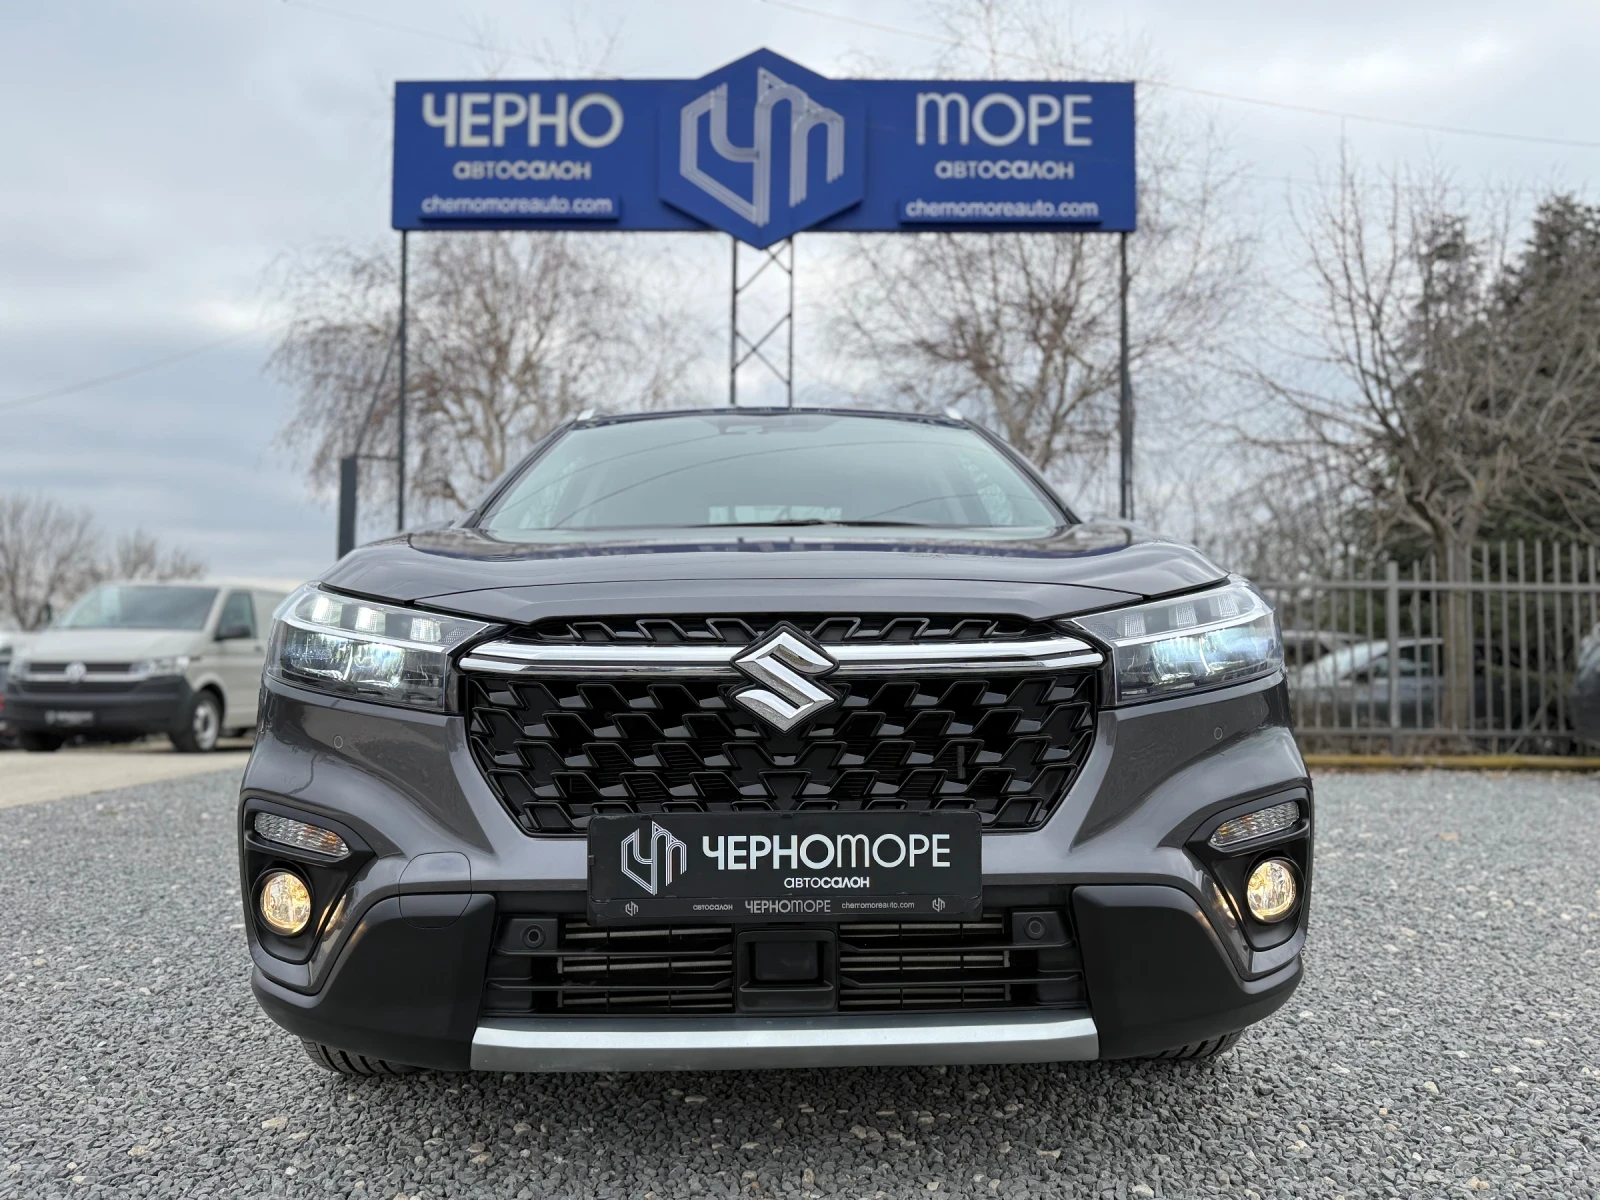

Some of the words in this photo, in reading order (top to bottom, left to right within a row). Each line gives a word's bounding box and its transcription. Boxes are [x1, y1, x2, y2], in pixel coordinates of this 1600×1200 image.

[422, 92, 624, 149] ЧЕРНО
[916, 92, 1093, 147] МОРЕ
[453, 161, 592, 181] автосалон
[934, 160, 1075, 180] автосалон
[421, 195, 613, 214] chernomoreauto.com
[905, 198, 1099, 218] chernomoreauto.com
[702, 833, 951, 871] ЧЕРНОМОРЕ
[745, 899, 831, 914] ЧЕРНОМОРЕ
